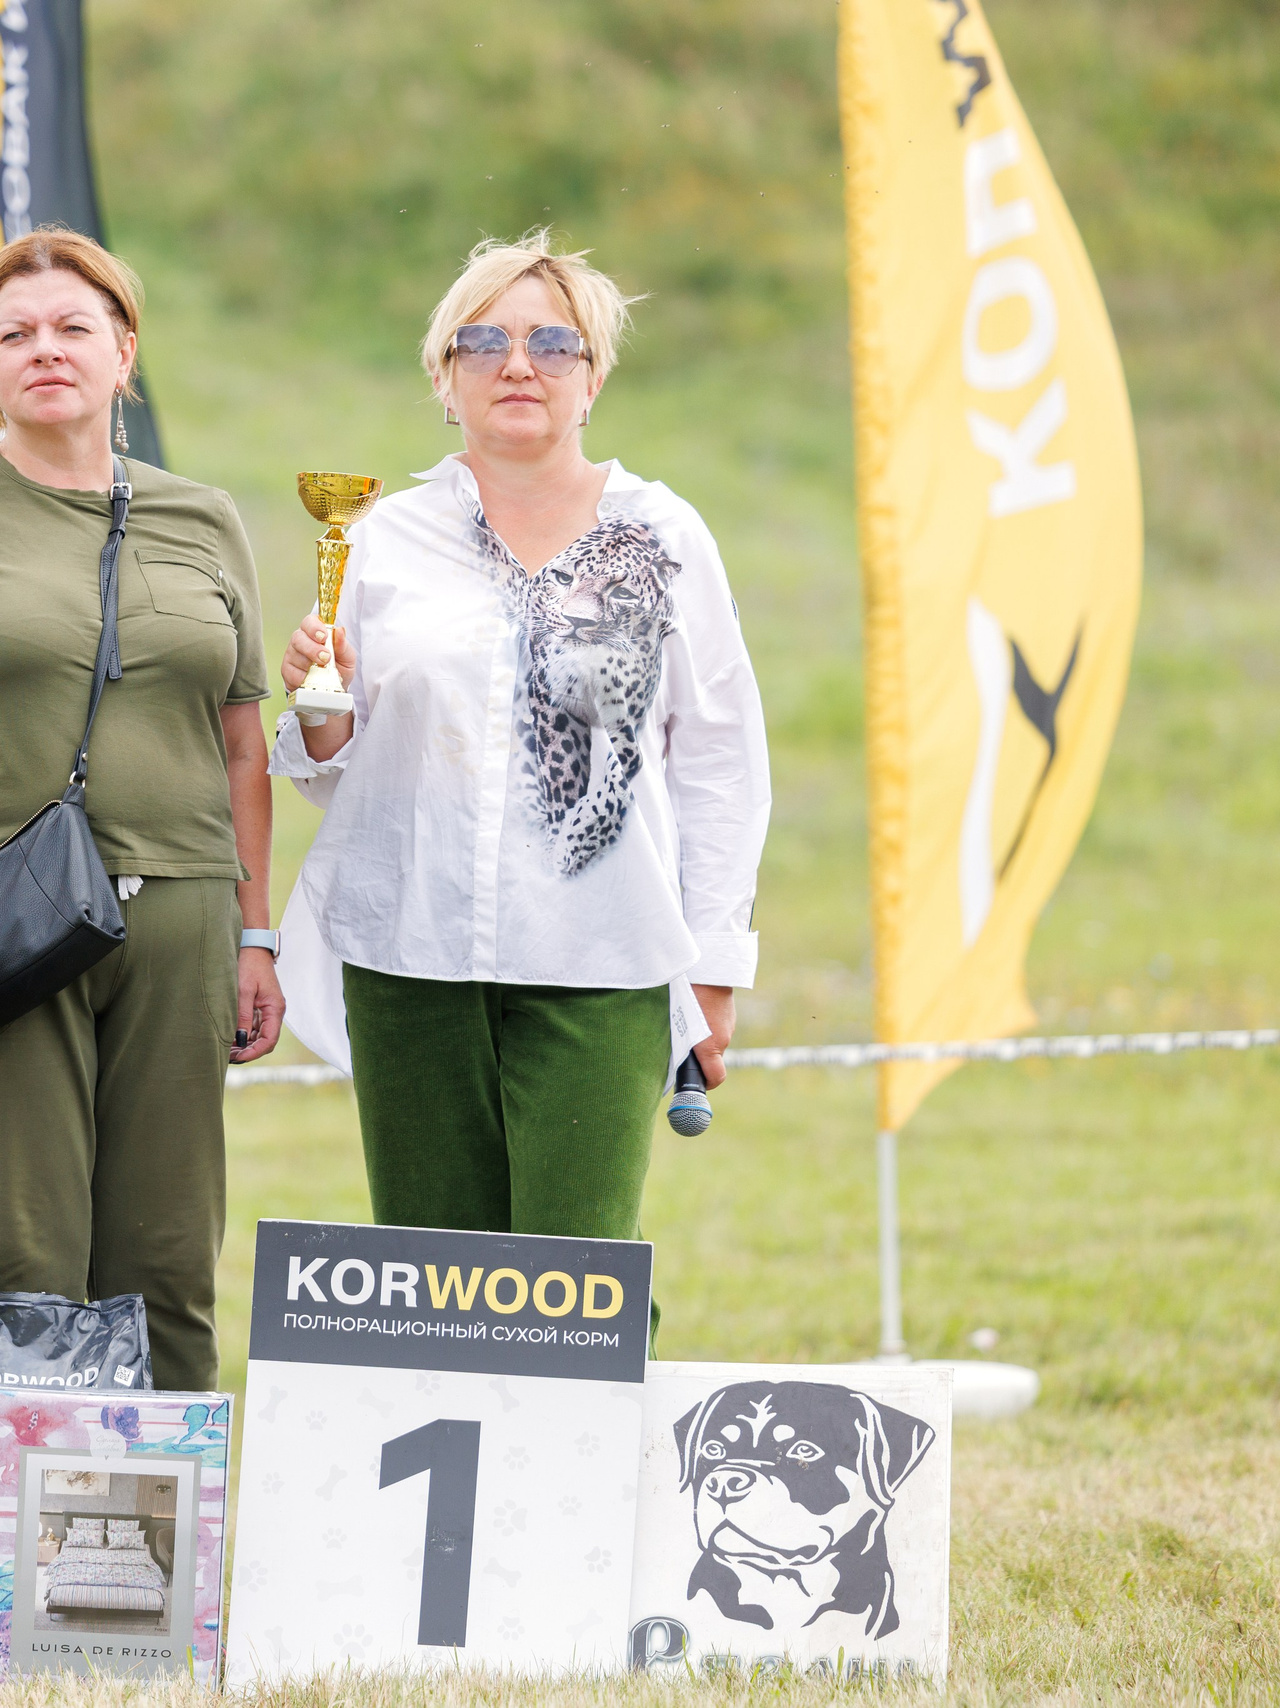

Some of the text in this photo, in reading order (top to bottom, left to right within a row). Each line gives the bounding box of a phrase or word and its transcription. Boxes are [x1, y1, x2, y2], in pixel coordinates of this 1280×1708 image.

[287, 1255, 624, 1319] KORWOOD
[283, 1313, 620, 1348] ПОЛНОРАЦИОННЫЙ СУХОЙ КОРМ
[378, 1418, 482, 1648] 1
[32, 1643, 172, 1659] LUISA DE RIZZO
